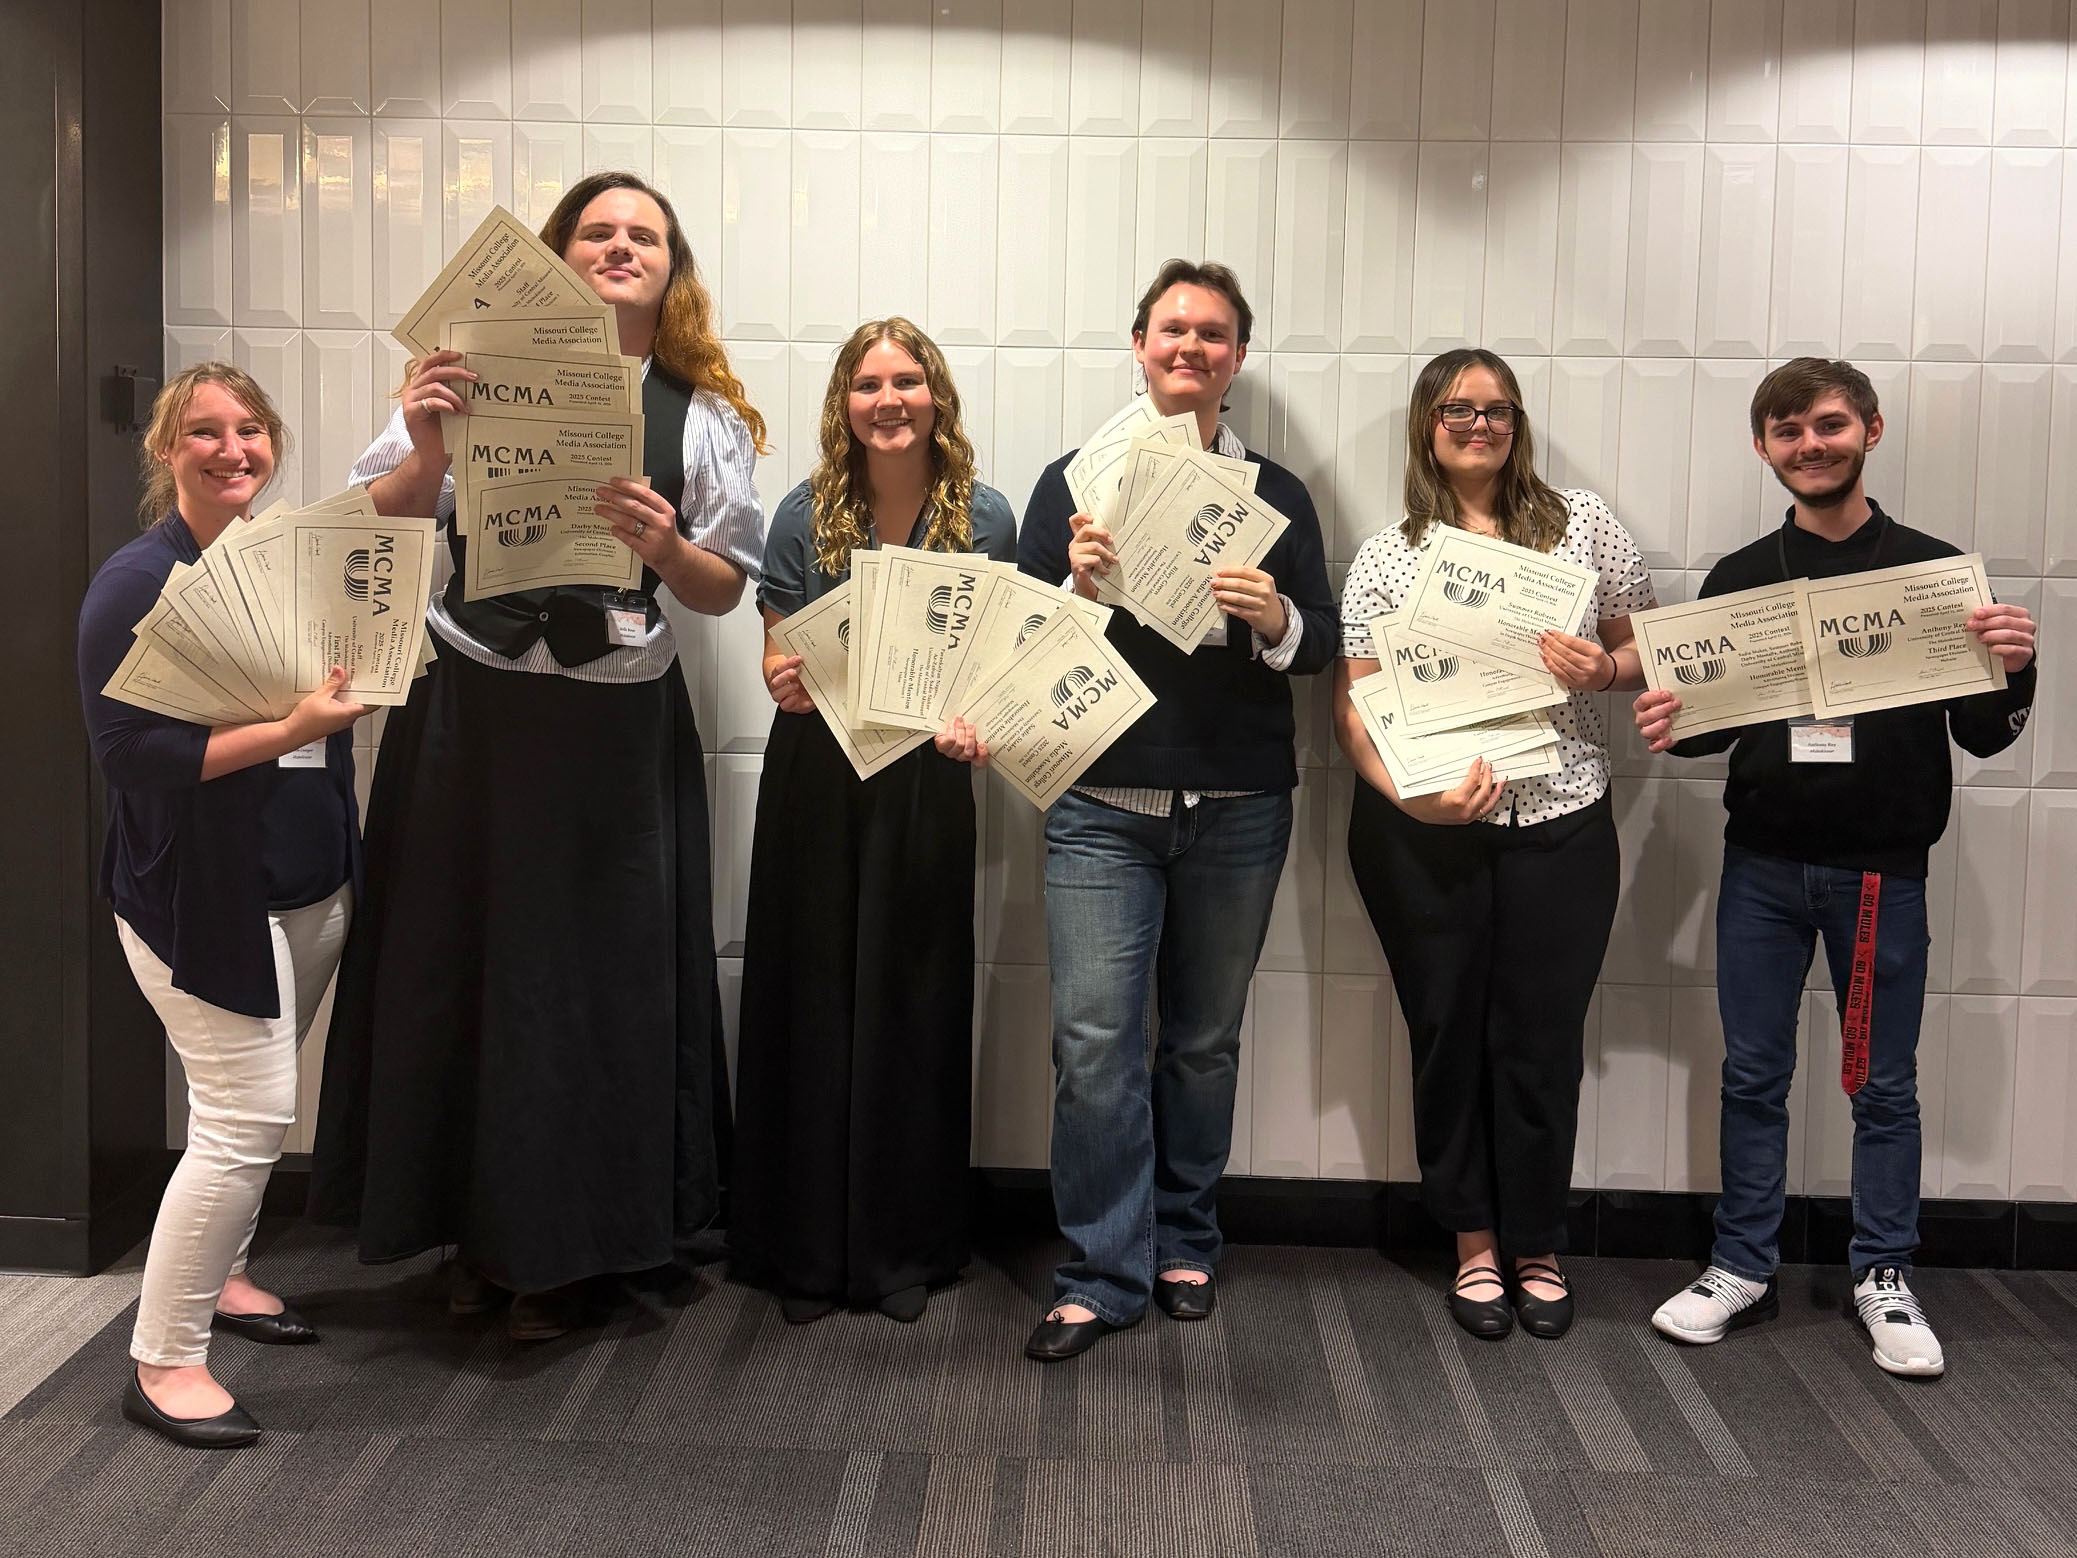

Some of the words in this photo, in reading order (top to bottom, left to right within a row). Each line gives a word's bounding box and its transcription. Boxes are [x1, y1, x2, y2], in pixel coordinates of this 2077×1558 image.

[468, 253, 492, 280] Missouri
[489, 233, 509, 255] College
[475, 270, 494, 288] Media
[491, 239, 519, 271] Association
[494, 275, 506, 288] 2025
[504, 257, 522, 277] Contest
[516, 281, 530, 295] Staff
[534, 326, 567, 334] Missouri
[569, 326, 598, 338] College
[558, 336, 602, 344] Association
[470, 382, 554, 406] MCMA
[557, 369, 591, 378] Missouri
[593, 372, 623, 383] College
[555, 378, 579, 387] Media
[581, 381, 625, 390] Association
[584, 394, 611, 403] Contest
[472, 444, 556, 465] MCMA
[559, 429, 593, 438] Missouri
[595, 431, 624, 441] College
[586, 454, 612, 464] Contest
[484, 504, 562, 530] MCMA
[567, 485, 597, 495] Missou
[1193, 503, 1249, 566] MCMA
[1146, 545, 1169, 572] Honorable
[372, 534, 394, 617] MCMA
[1130, 572, 1149, 593] Mention
[1165, 565, 1178, 579] Riley
[1184, 577, 1195, 590] 2025
[1196, 574, 1213, 593] Media
[1435, 560, 1505, 594] MCMA
[1520, 565, 1549, 579] Missouri
[1550, 575, 1576, 588] College
[1154, 580, 1168, 595] Green
[1514, 572, 1535, 583] Media
[1536, 579, 1575, 597] Association
[1903, 593, 1929, 603] Media
[1931, 586, 1974, 599] Association
[1904, 583, 1939, 593] Missouri
[1940, 577, 1969, 586] College
[1169, 589, 1186, 609] Contest
[1171, 593, 1198, 626] Association
[1730, 606, 1764, 619] Missouri
[1765, 601, 1795, 612] College
[1937, 602, 1963, 611] Contest
[947, 573, 976, 650] MCMA
[1181, 607, 1200, 630] College
[391, 618, 399, 643] Media
[1498, 619, 1529, 632] Honorable
[1730, 620, 1755, 629] Media
[1764, 626, 1790, 636] Contest
[1820, 609, 1906, 638] MCMA
[1922, 625, 1952, 634] Anthony
[397, 621, 408, 655] Missouri
[1928, 645, 1947, 654] Third
[374, 648, 383, 673] Contest
[1396, 643, 1437, 666] MC
[1656, 636, 1737, 666] MCMA
[382, 644, 395, 688] Association
[390, 657, 402, 686] College
[909, 648, 918, 682] Honorable
[1749, 669, 1785, 681] Honorable
[1786, 664, 1806, 672] Menti
[1051, 670, 1117, 730] MCMA
[1004, 700, 1030, 725] Honorable
[984, 724, 1006, 745] Mention
[1021, 723, 1036, 737] Sadie
[1005, 736, 1023, 754] Staker
[1037, 739, 1049, 752] 2025
[1049, 740, 1068, 758] Media
[1021, 750, 1039, 768] Contest
[1024, 757, 1051, 783] Association
[1049, 749, 1073, 774] Missouri
[1033, 771, 1052, 788] College
[1858, 908, 1872, 943] MULES
[1849, 974, 1864, 1009] MULES
